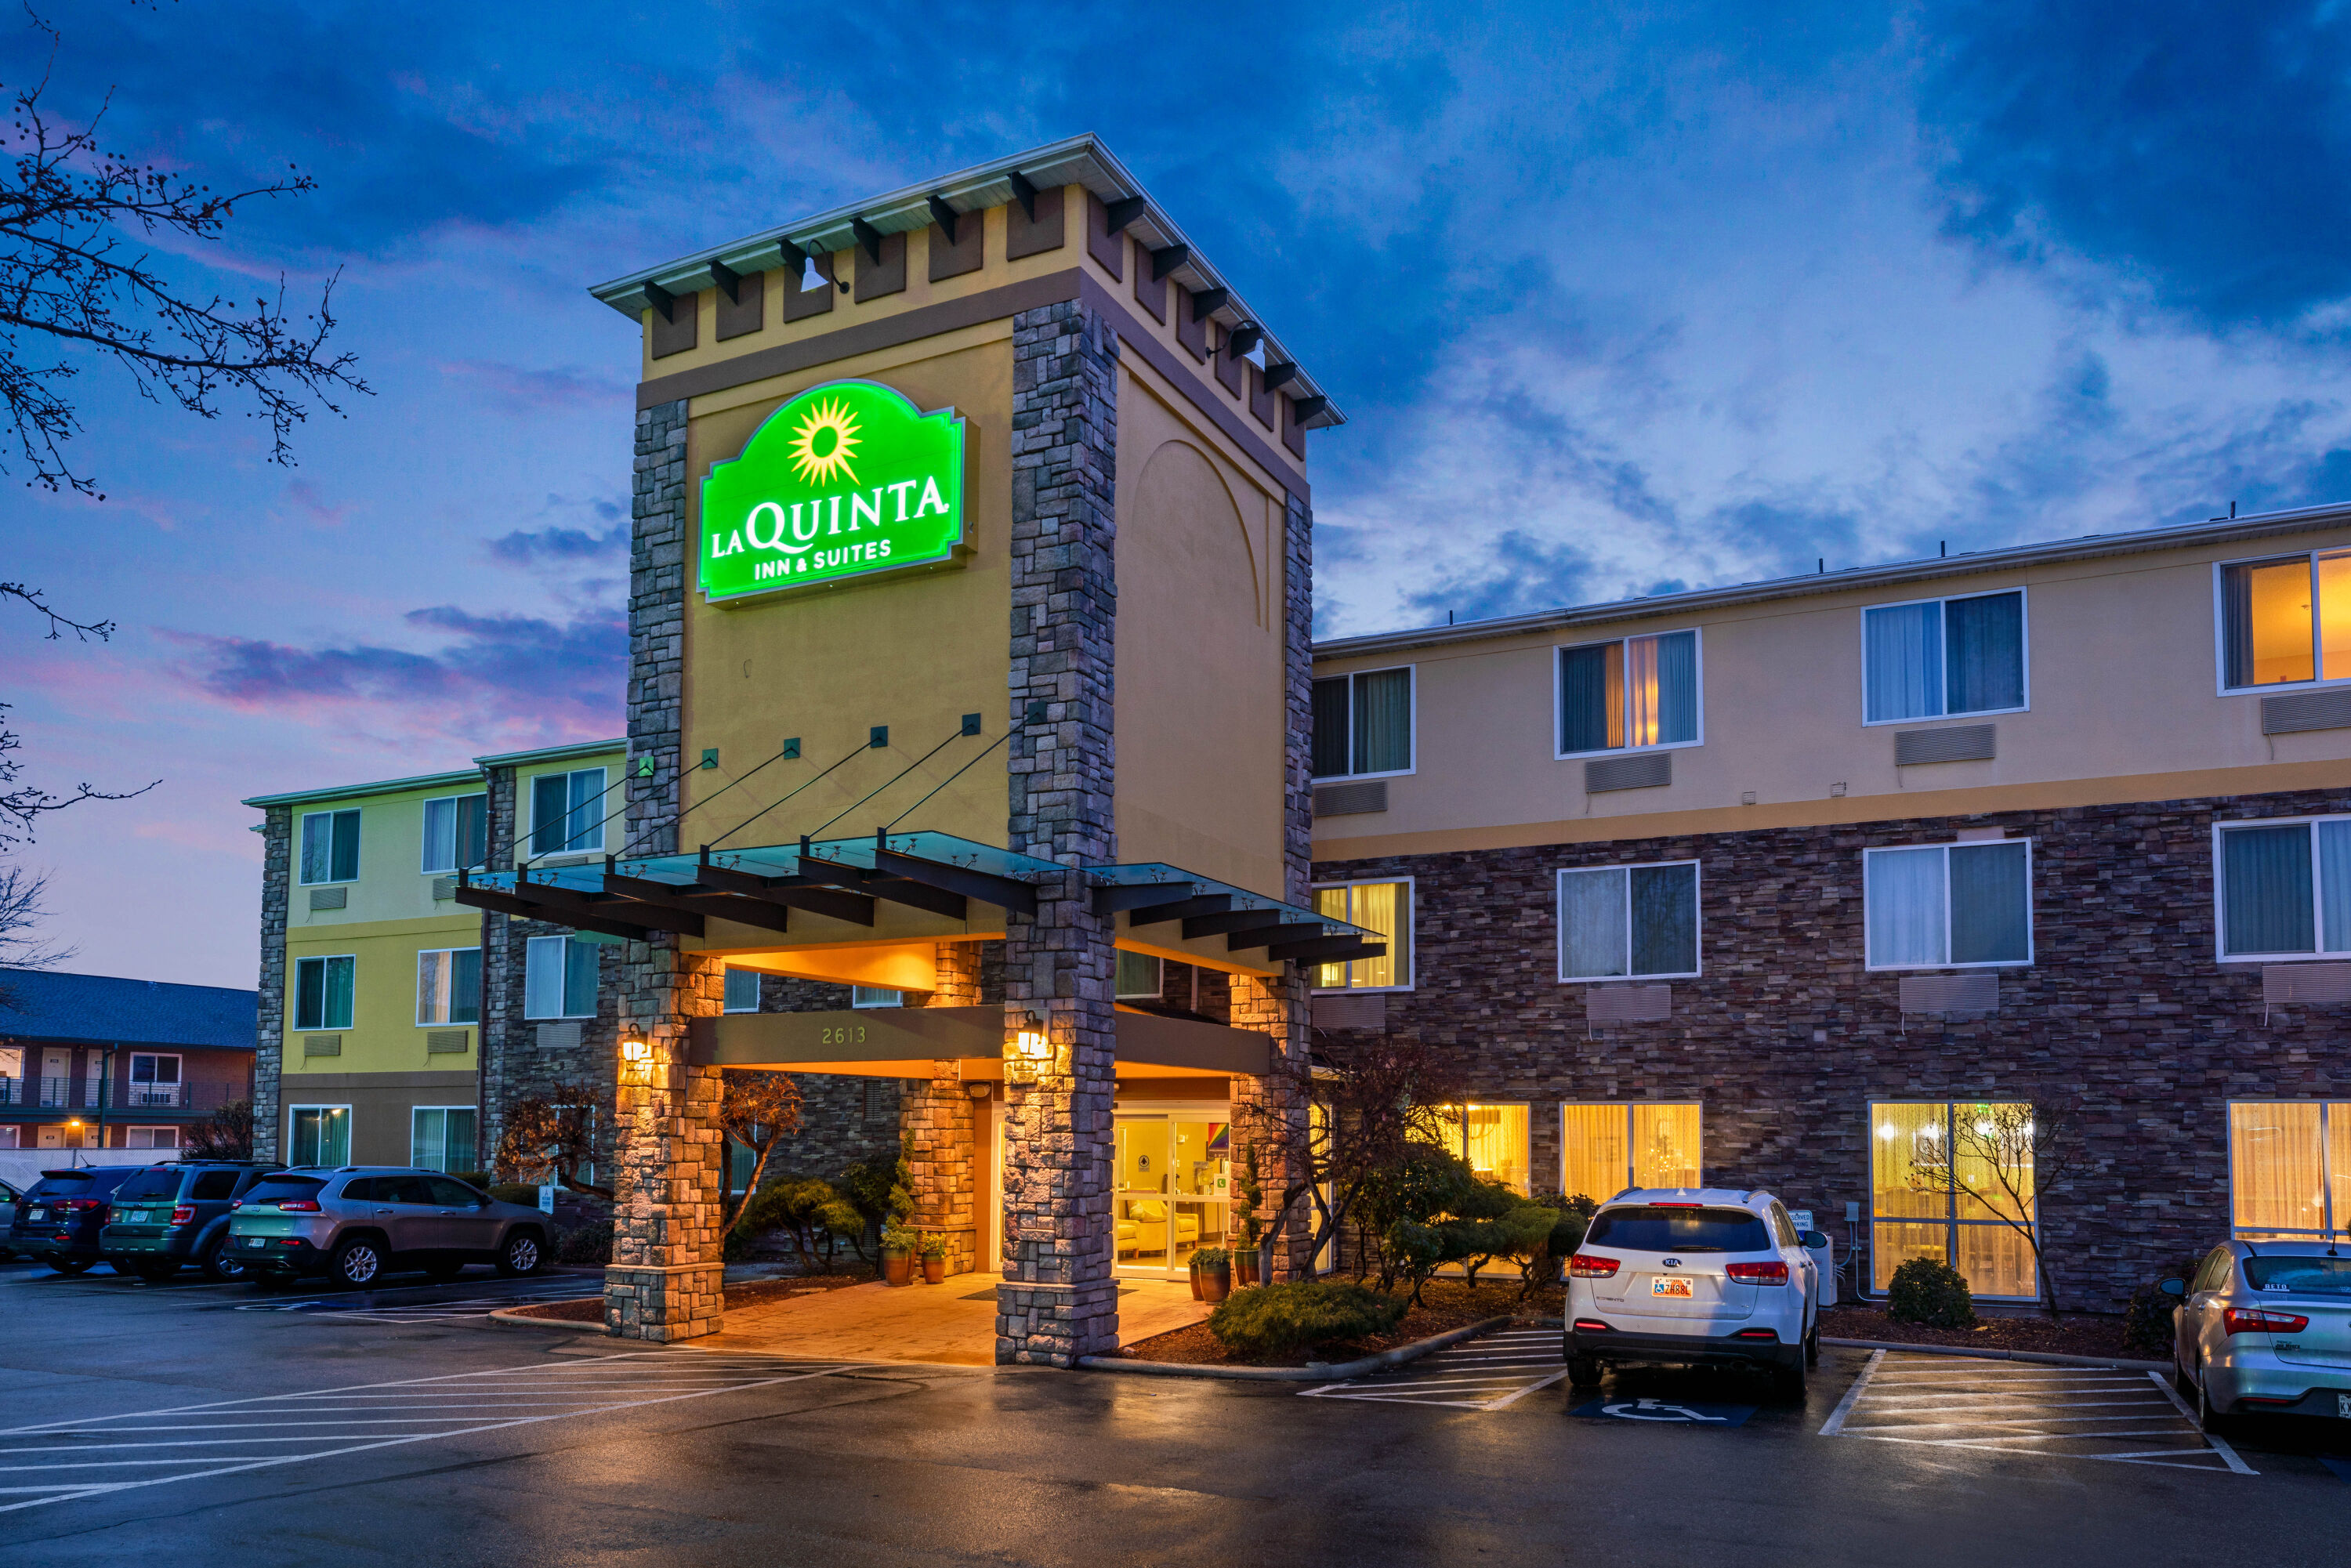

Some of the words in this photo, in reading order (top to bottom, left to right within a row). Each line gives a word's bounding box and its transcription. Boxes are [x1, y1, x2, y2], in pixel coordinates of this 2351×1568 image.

[711, 529, 745, 558] LA
[745, 475, 947, 555] QUINTA
[754, 558, 790, 581] INN
[795, 558, 807, 573] &
[813, 539, 892, 570] SUITES
[822, 1026, 866, 1045] 2613
